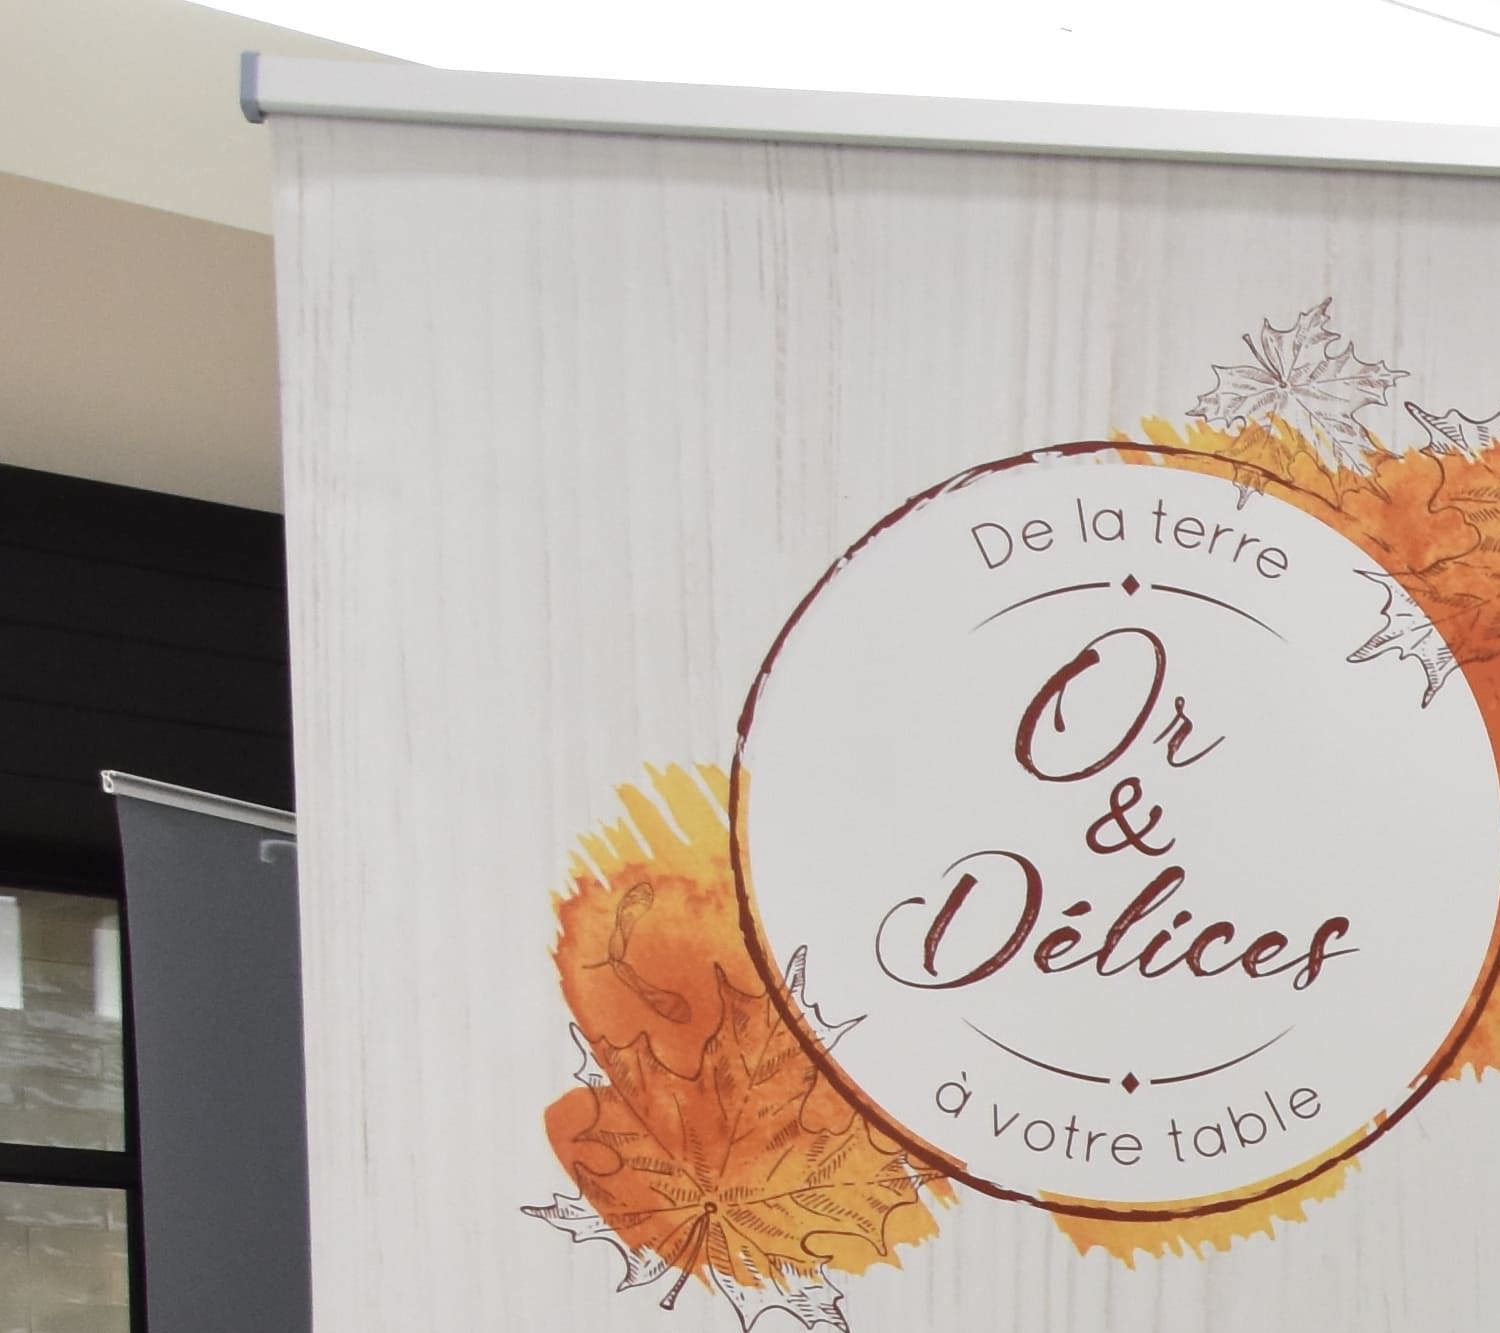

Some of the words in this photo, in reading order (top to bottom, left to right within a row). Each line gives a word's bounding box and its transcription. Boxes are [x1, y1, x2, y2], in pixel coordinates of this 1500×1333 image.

[971, 520, 1053, 569] De
[1077, 498, 1124, 542] la
[1151, 500, 1290, 581] terre
[1014, 626, 1225, 782] Or
[1086, 775, 1176, 857] &
[875, 850, 1360, 990] Délices
[936, 1072, 972, 1118] à
[988, 1094, 1145, 1170] votre
[1166, 1076, 1325, 1162] table
